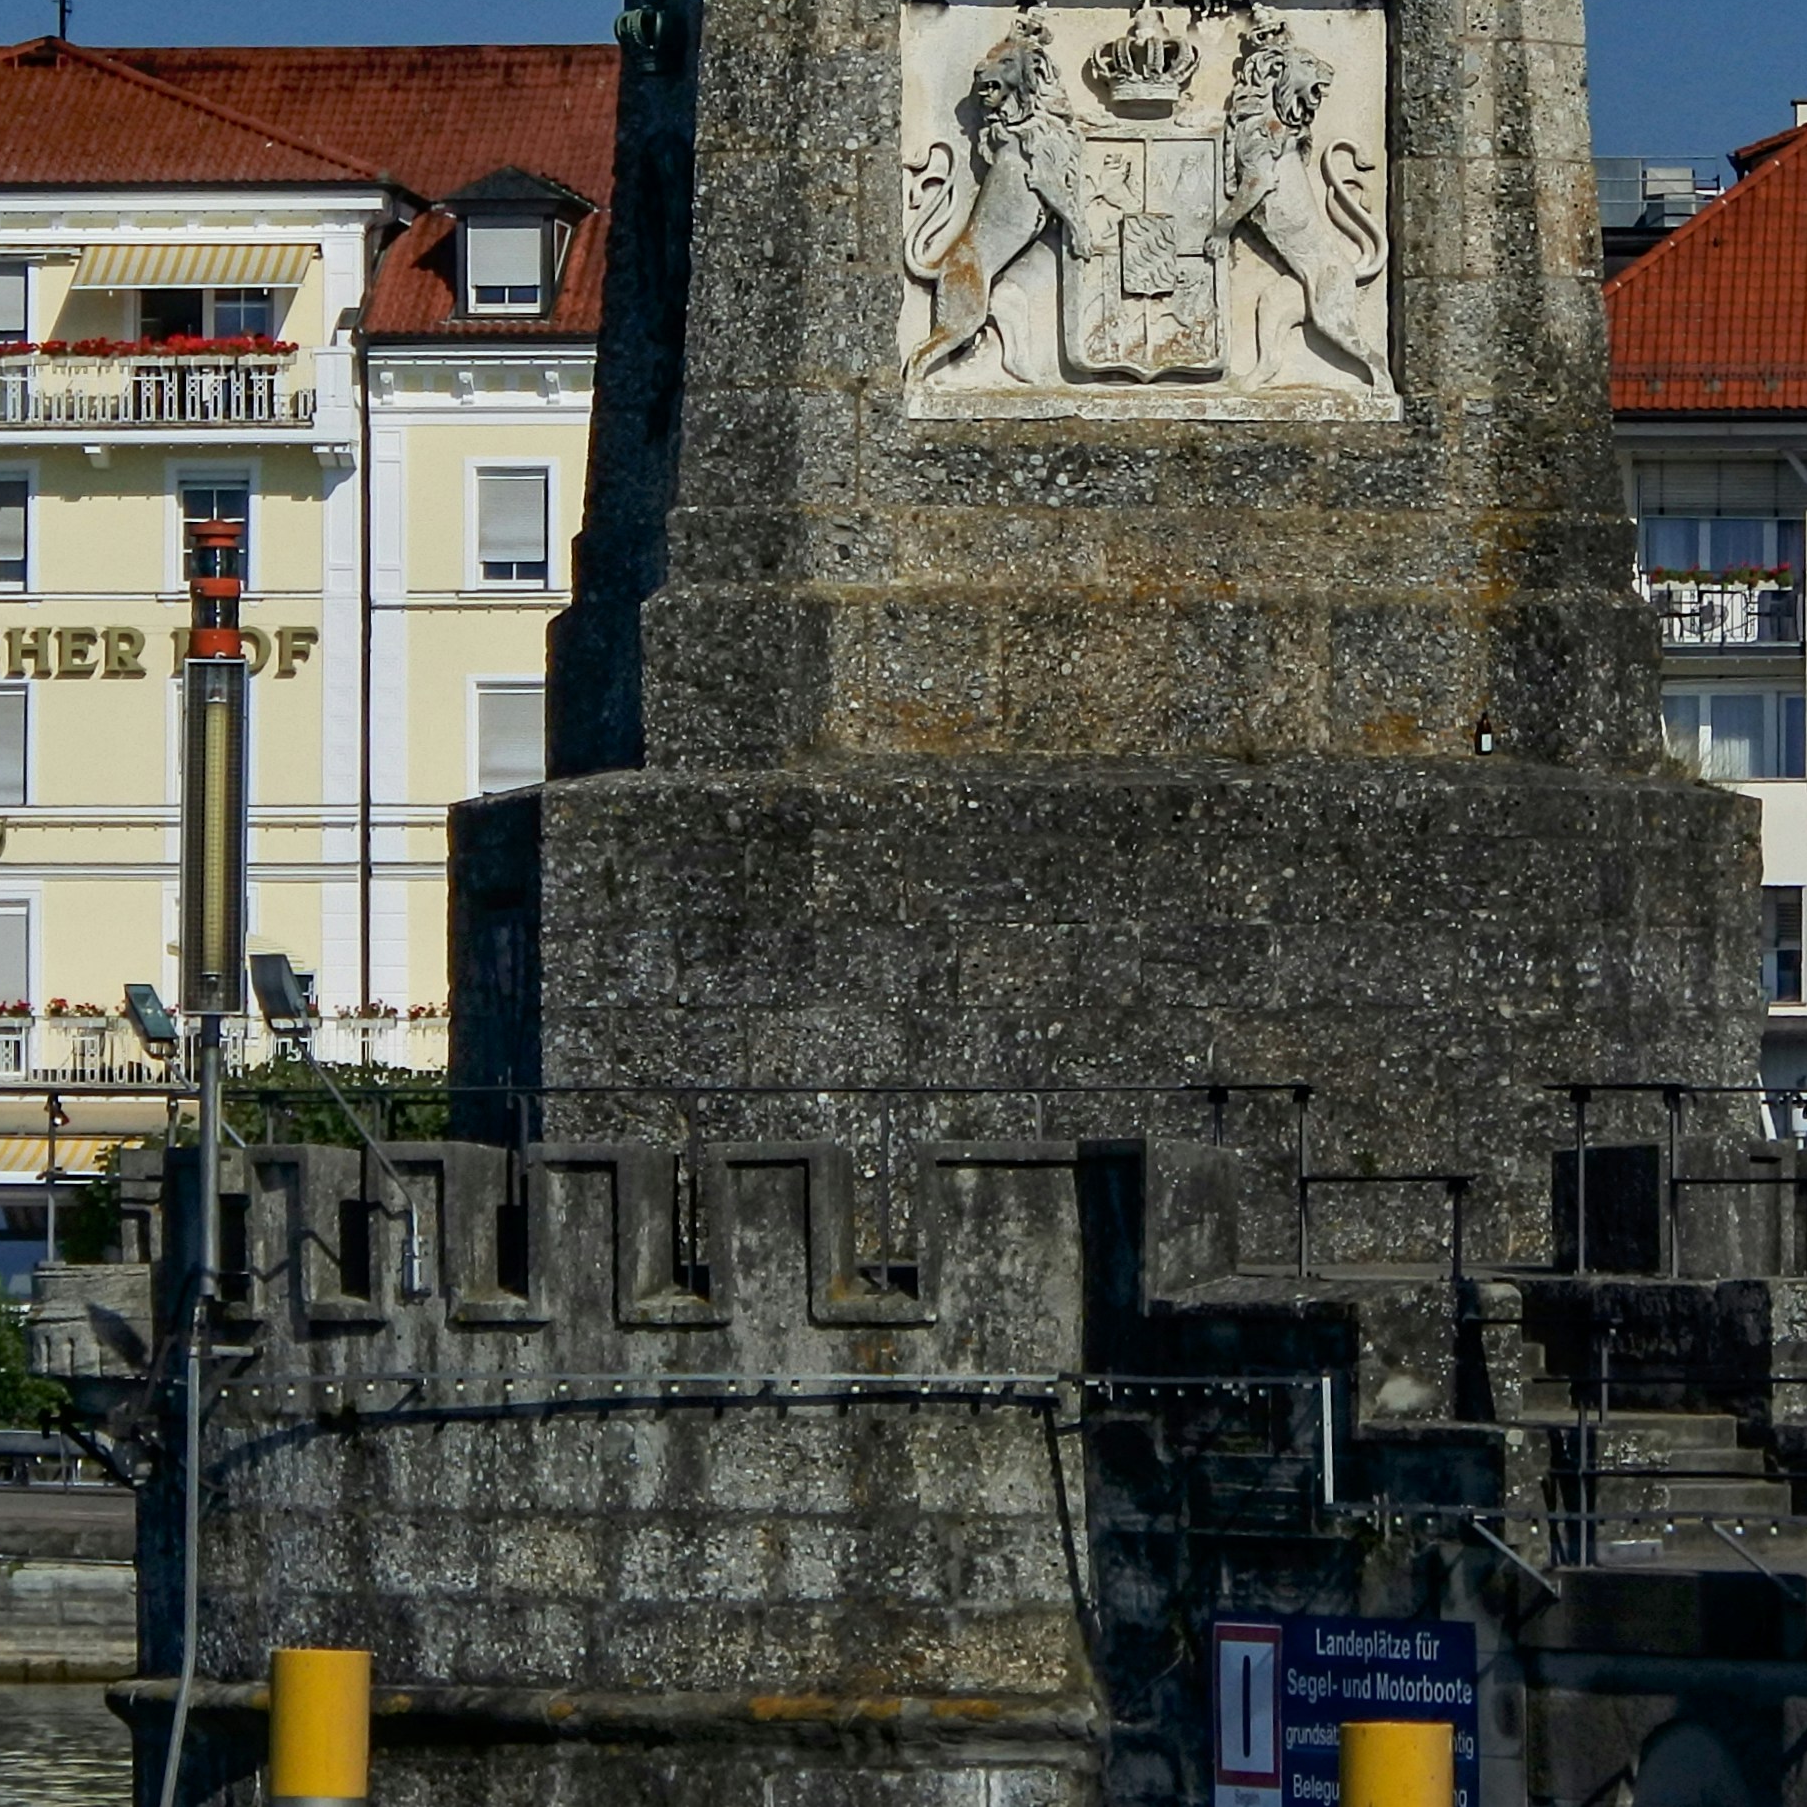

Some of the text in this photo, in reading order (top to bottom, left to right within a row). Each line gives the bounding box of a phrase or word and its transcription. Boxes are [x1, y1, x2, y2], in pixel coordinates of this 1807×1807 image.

[1315, 1628, 1440, 1663] Landeplätze für
[1287, 1668, 1473, 1705] Segel- und Motorboote
[1286, 1723, 1340, 1749] grundsät
